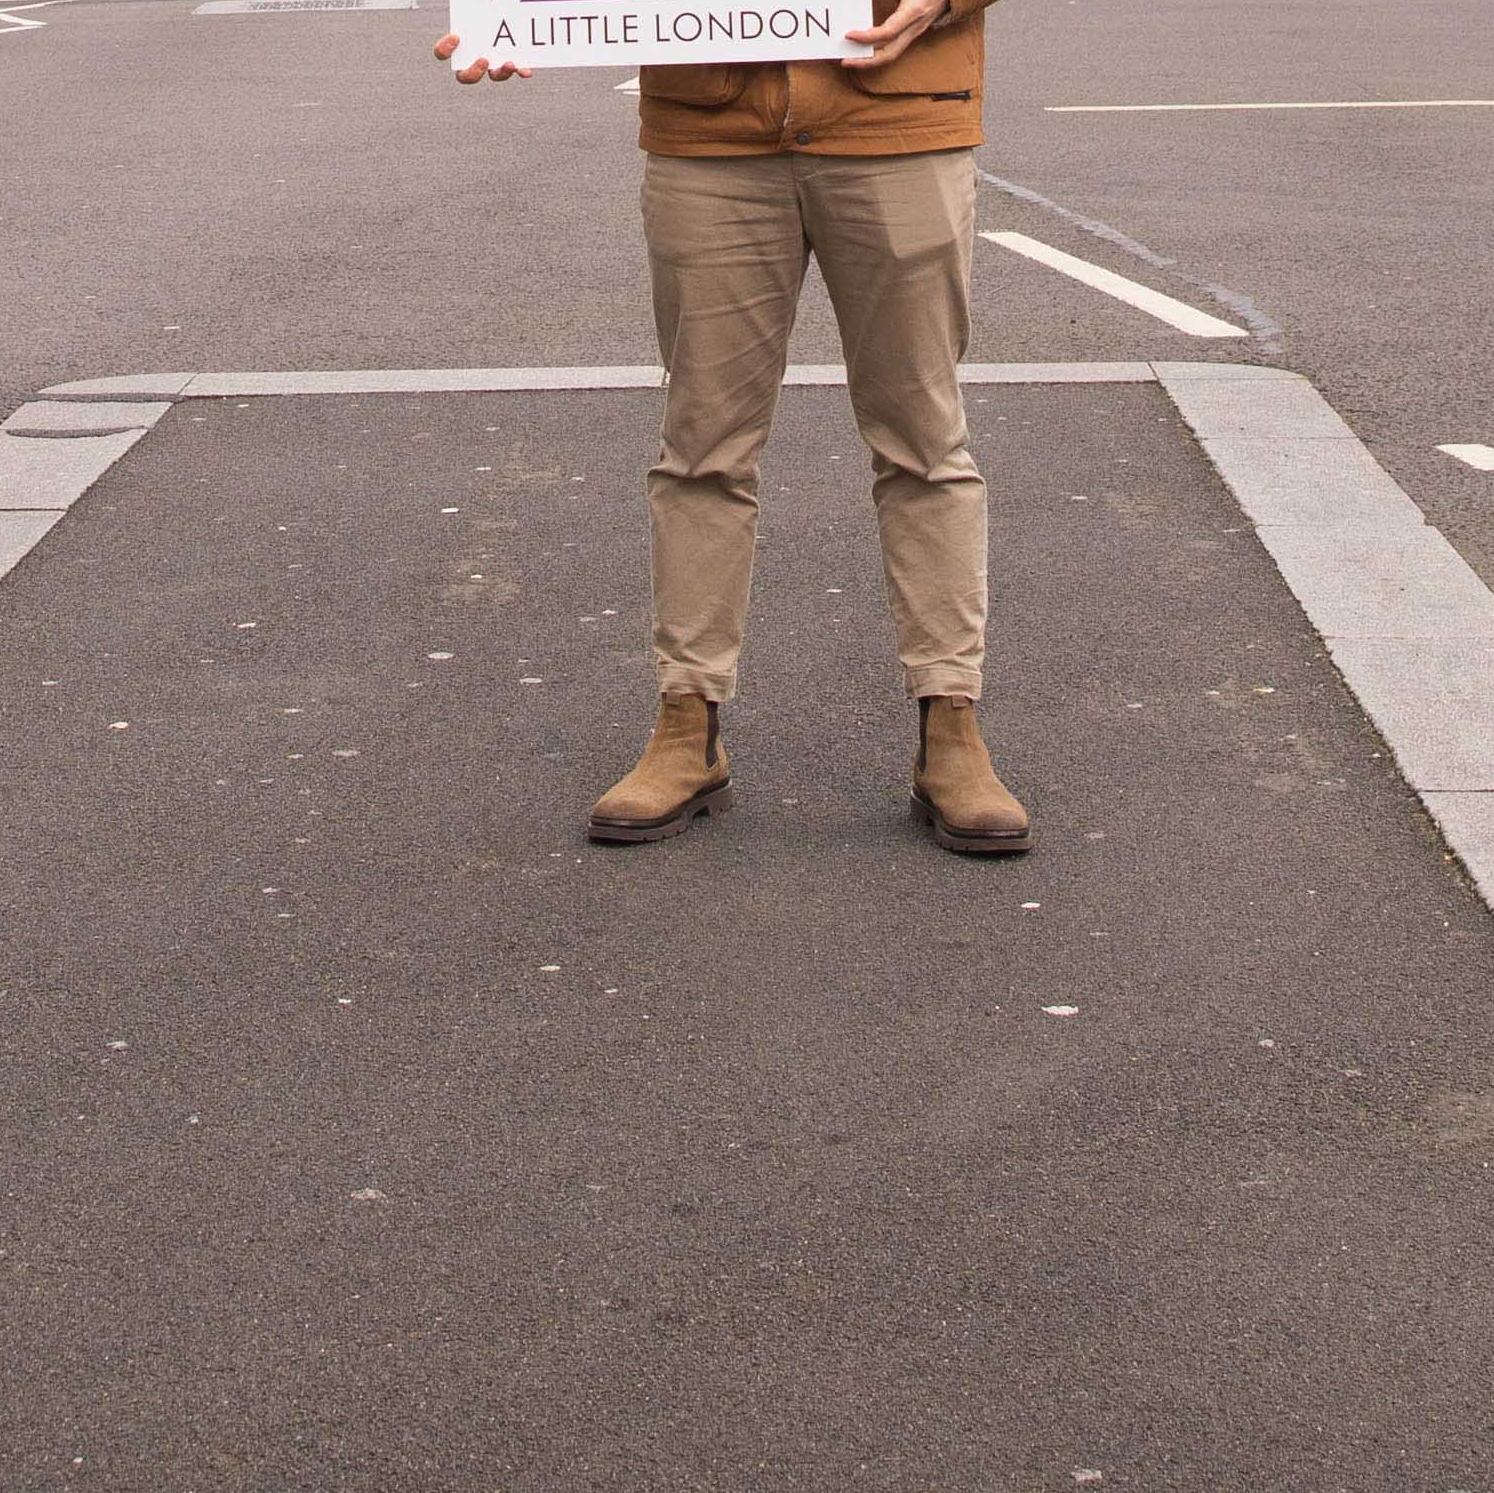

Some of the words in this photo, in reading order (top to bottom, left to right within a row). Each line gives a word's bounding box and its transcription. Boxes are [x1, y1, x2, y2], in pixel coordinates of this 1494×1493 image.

[492, 19, 516, 47] A
[531, 14, 638, 45] LITTLE
[656, 8, 831, 43] LONDON
